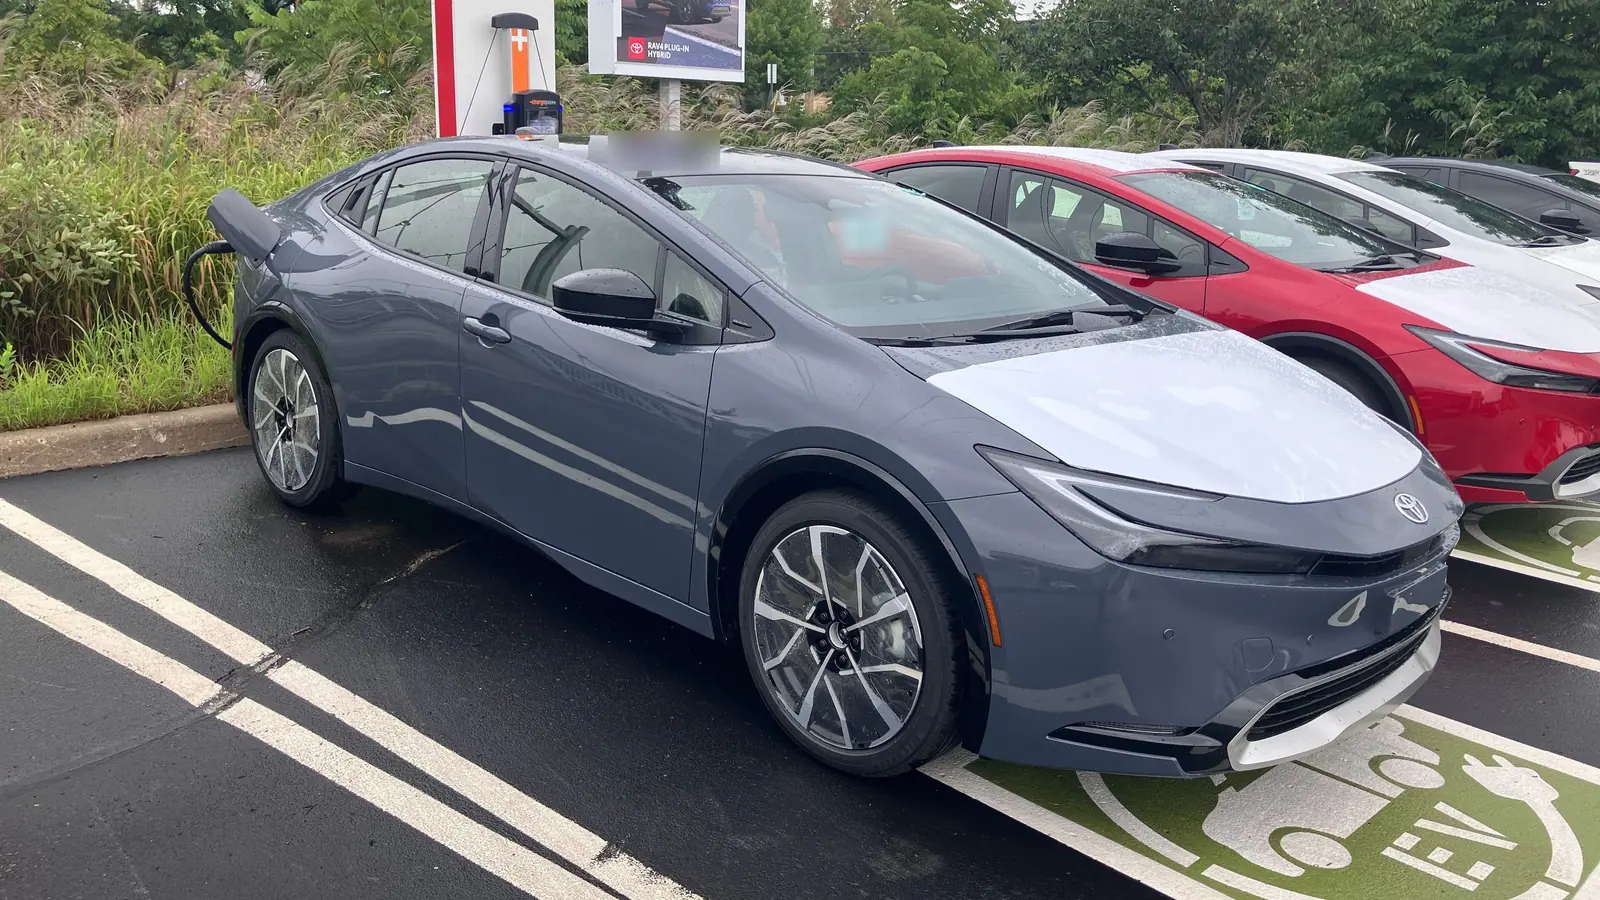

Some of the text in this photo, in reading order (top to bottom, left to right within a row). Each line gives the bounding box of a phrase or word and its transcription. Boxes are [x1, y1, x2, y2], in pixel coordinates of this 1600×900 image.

[647, 42, 690, 53] RAV4 PLUG-IN
[647, 50, 671, 59] HYBRID
[1381, 801, 1518, 891] EV
